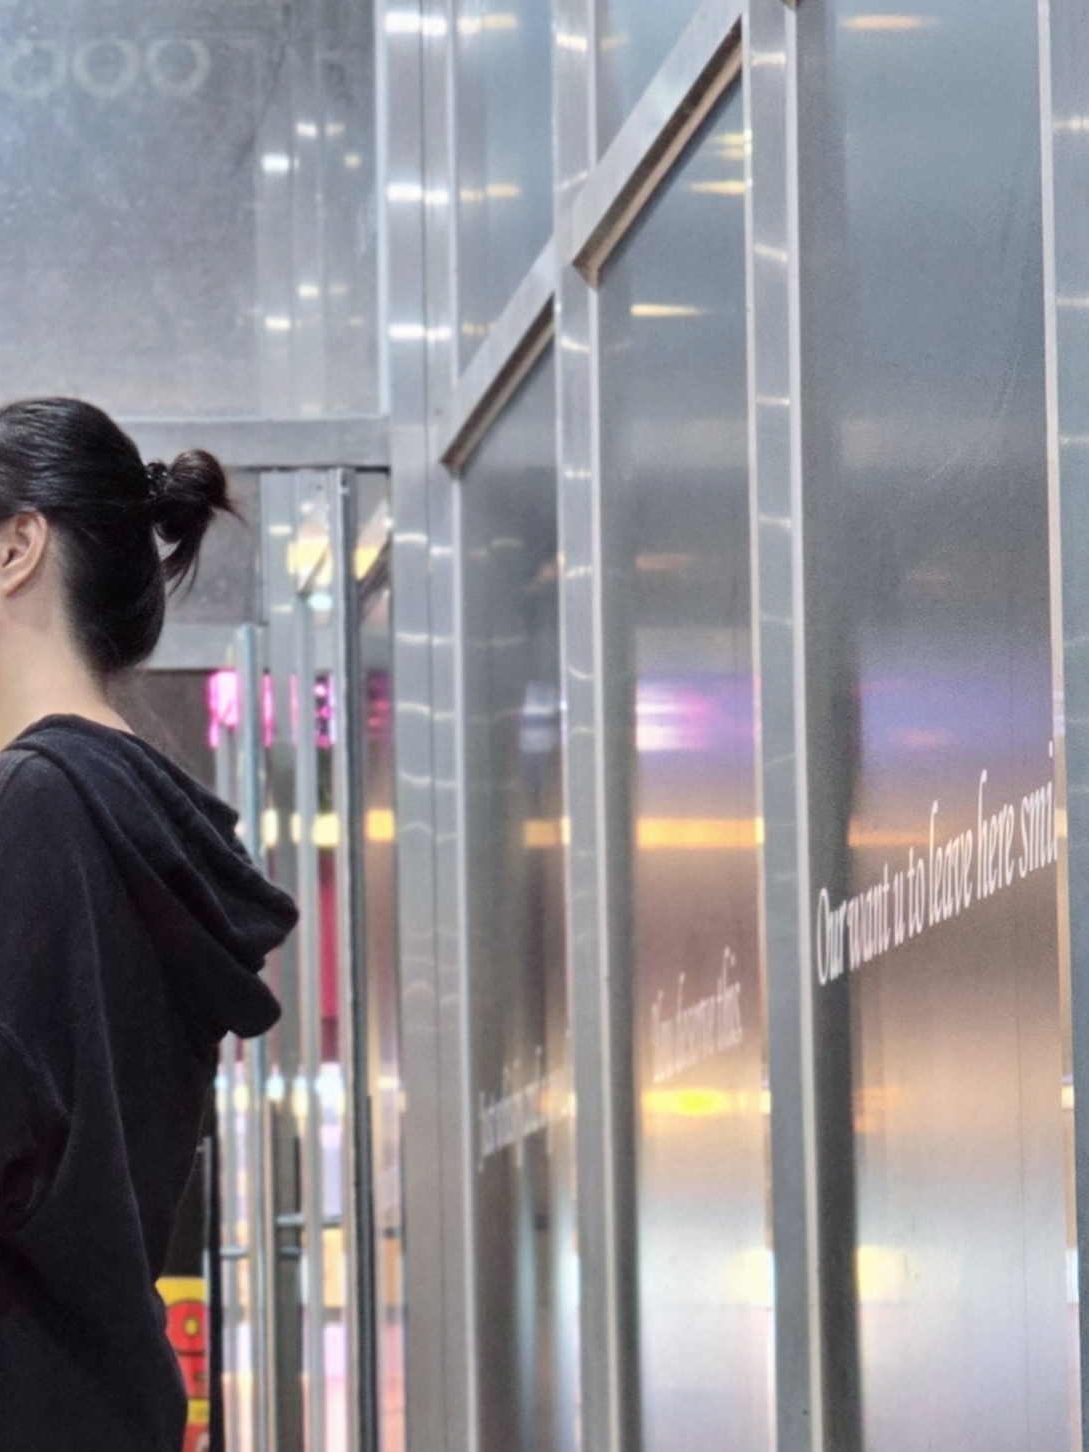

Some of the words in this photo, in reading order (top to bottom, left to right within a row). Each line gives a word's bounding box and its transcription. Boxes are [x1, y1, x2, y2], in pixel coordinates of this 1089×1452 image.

[817, 887, 847, 986] Our
[847, 862, 891, 971] want
[894, 870, 905, 946] u
[908, 846, 925, 938] to
[929, 800, 973, 926] leave
[977, 769, 1014, 900] here
